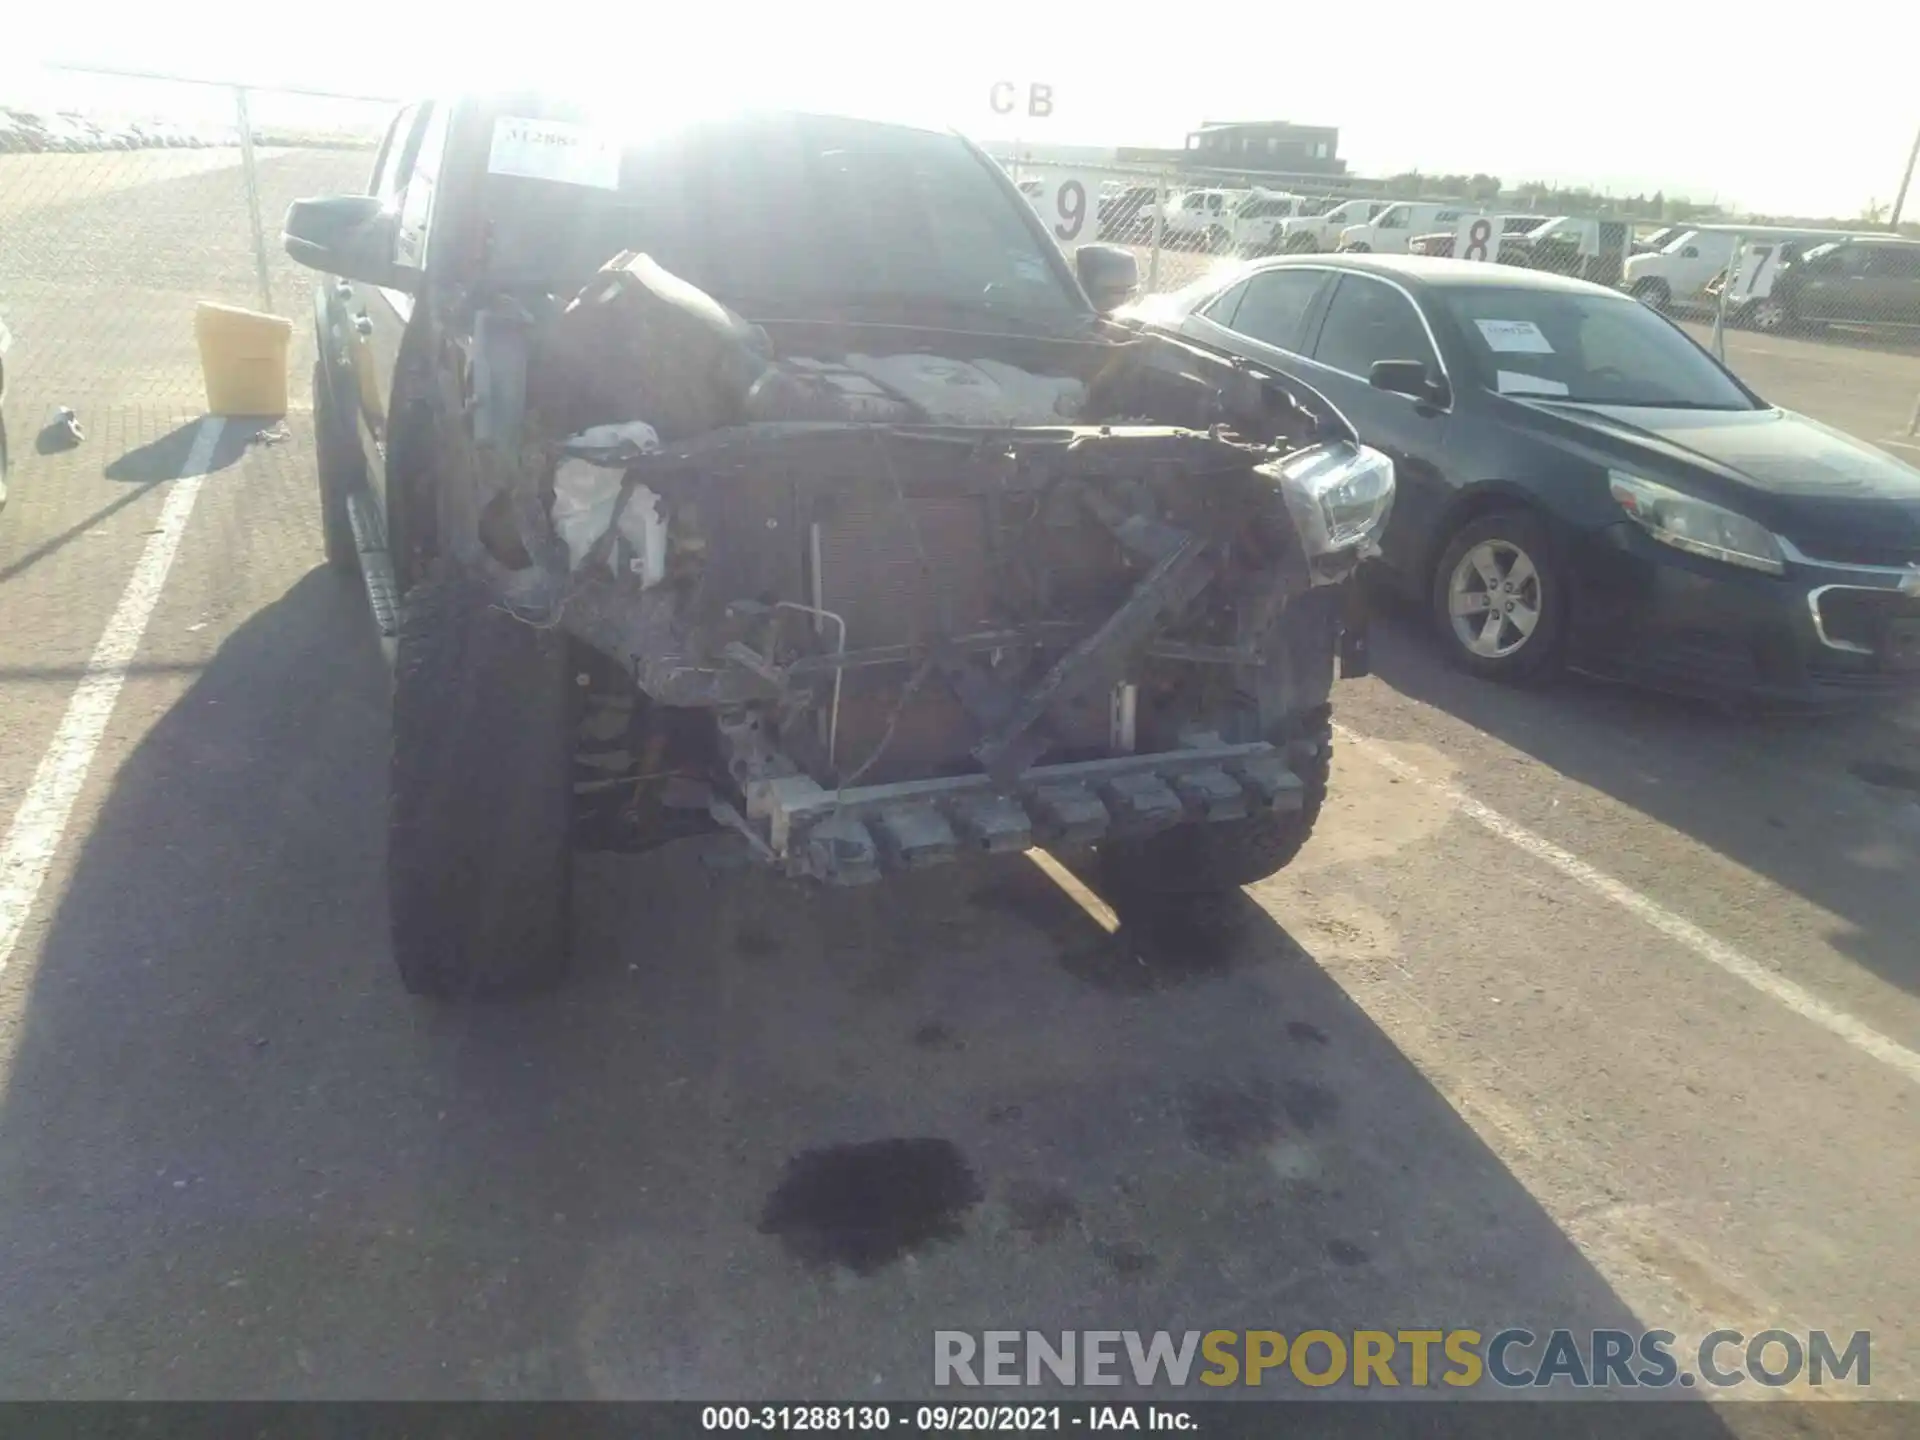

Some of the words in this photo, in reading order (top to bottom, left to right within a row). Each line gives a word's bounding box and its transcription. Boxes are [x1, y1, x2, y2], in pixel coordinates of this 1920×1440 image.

[1055, 179, 1086, 241] 9
[1464, 219, 1492, 262] 8
[1746, 246, 1774, 294] 7
